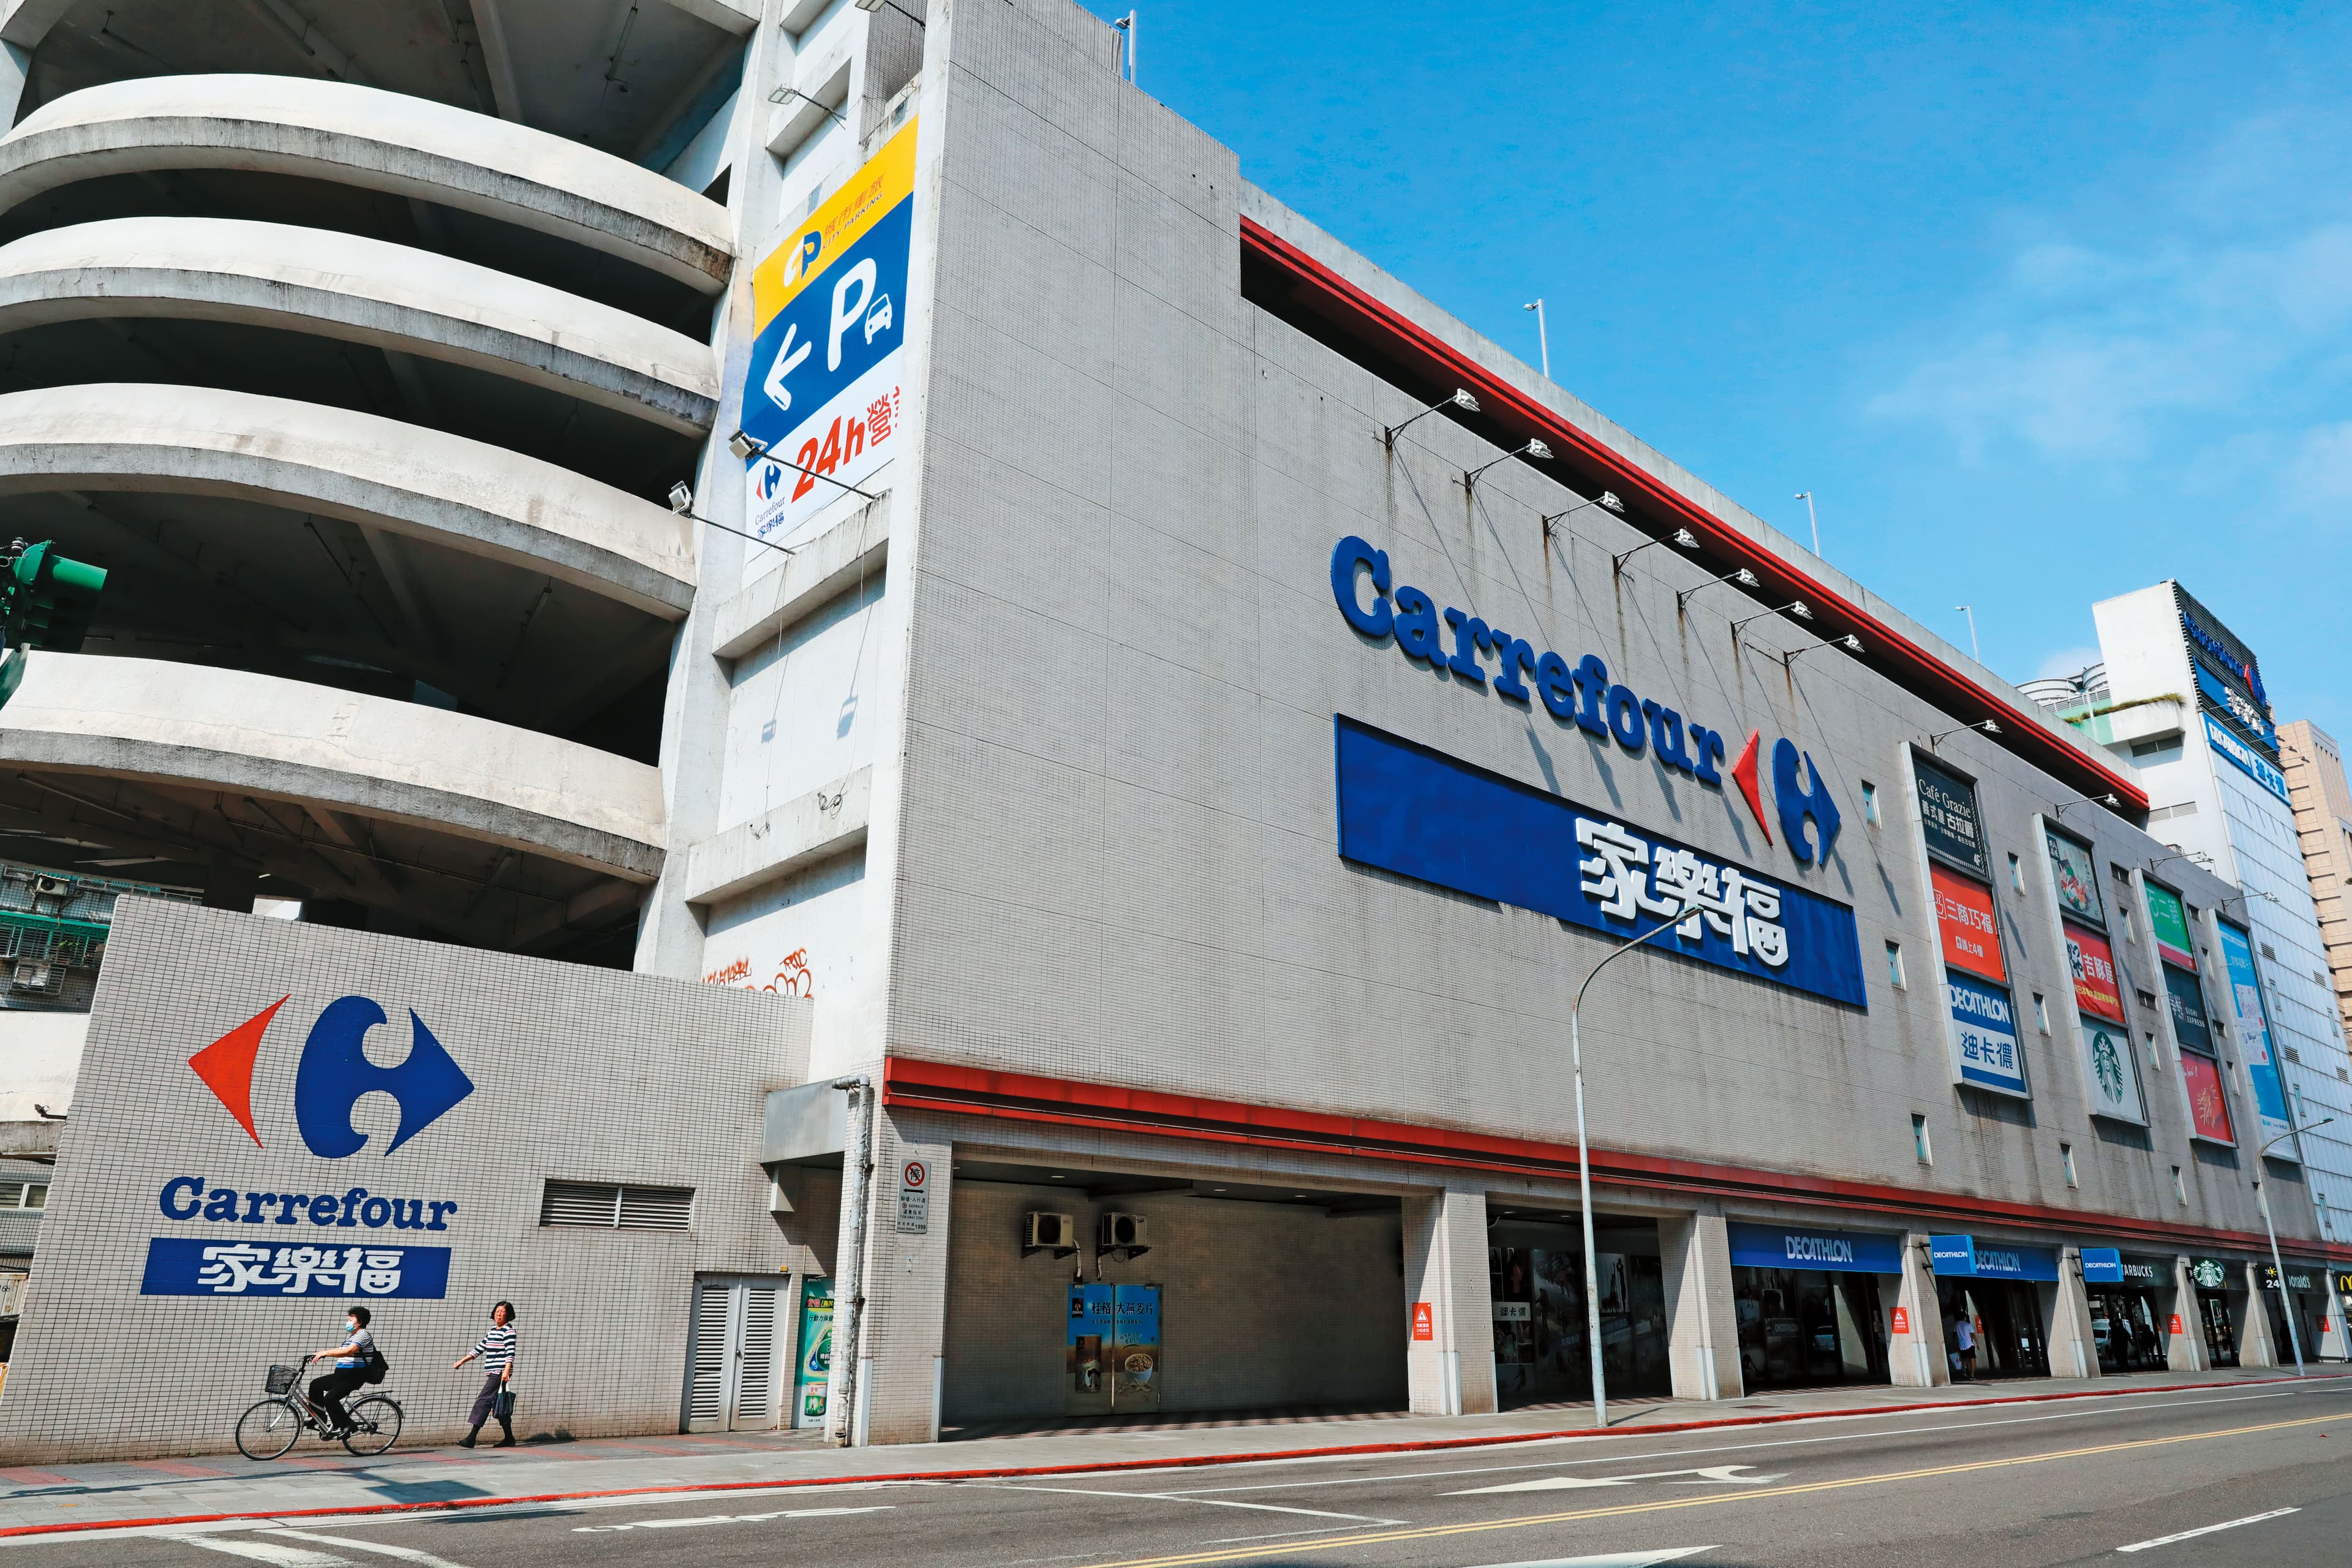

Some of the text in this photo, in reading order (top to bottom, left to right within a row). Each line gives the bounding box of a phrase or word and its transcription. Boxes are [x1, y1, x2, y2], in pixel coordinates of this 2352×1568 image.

[823, 191, 882, 249] CITY PARKING
[827, 258, 876, 372] P
[755, 497, 785, 525] Carrefour
[758, 511, 784, 539] 家樂福
[1331, 535, 1724, 785] Carrefour
[1918, 778, 1972, 818] Café Grazie
[1946, 812, 1974, 839] 古拉爵
[1576, 817, 1789, 966] 家樂福
[1945, 897, 1993, 933] 三商巧福
[1948, 984, 2011, 1023] DECATHLON
[2185, 1007, 2198, 1017] SUSHI
[2187, 1016, 2205, 1028] EXPRESS
[1961, 1031, 2013, 1069] 迪卡儂
[159, 1176, 458, 1231] Carrefour
[1785, 1235, 1853, 1263] DECATHLON
[1974, 1250, 2021, 1272] DECATHLON
[197, 1243, 404, 1294] 家樂福
[2121, 1264, 2154, 1278] TARBUCKS
[2266, 1280, 2280, 1288] 24
[1091, 1302, 1155, 1316] 桂格 大燕麥片
